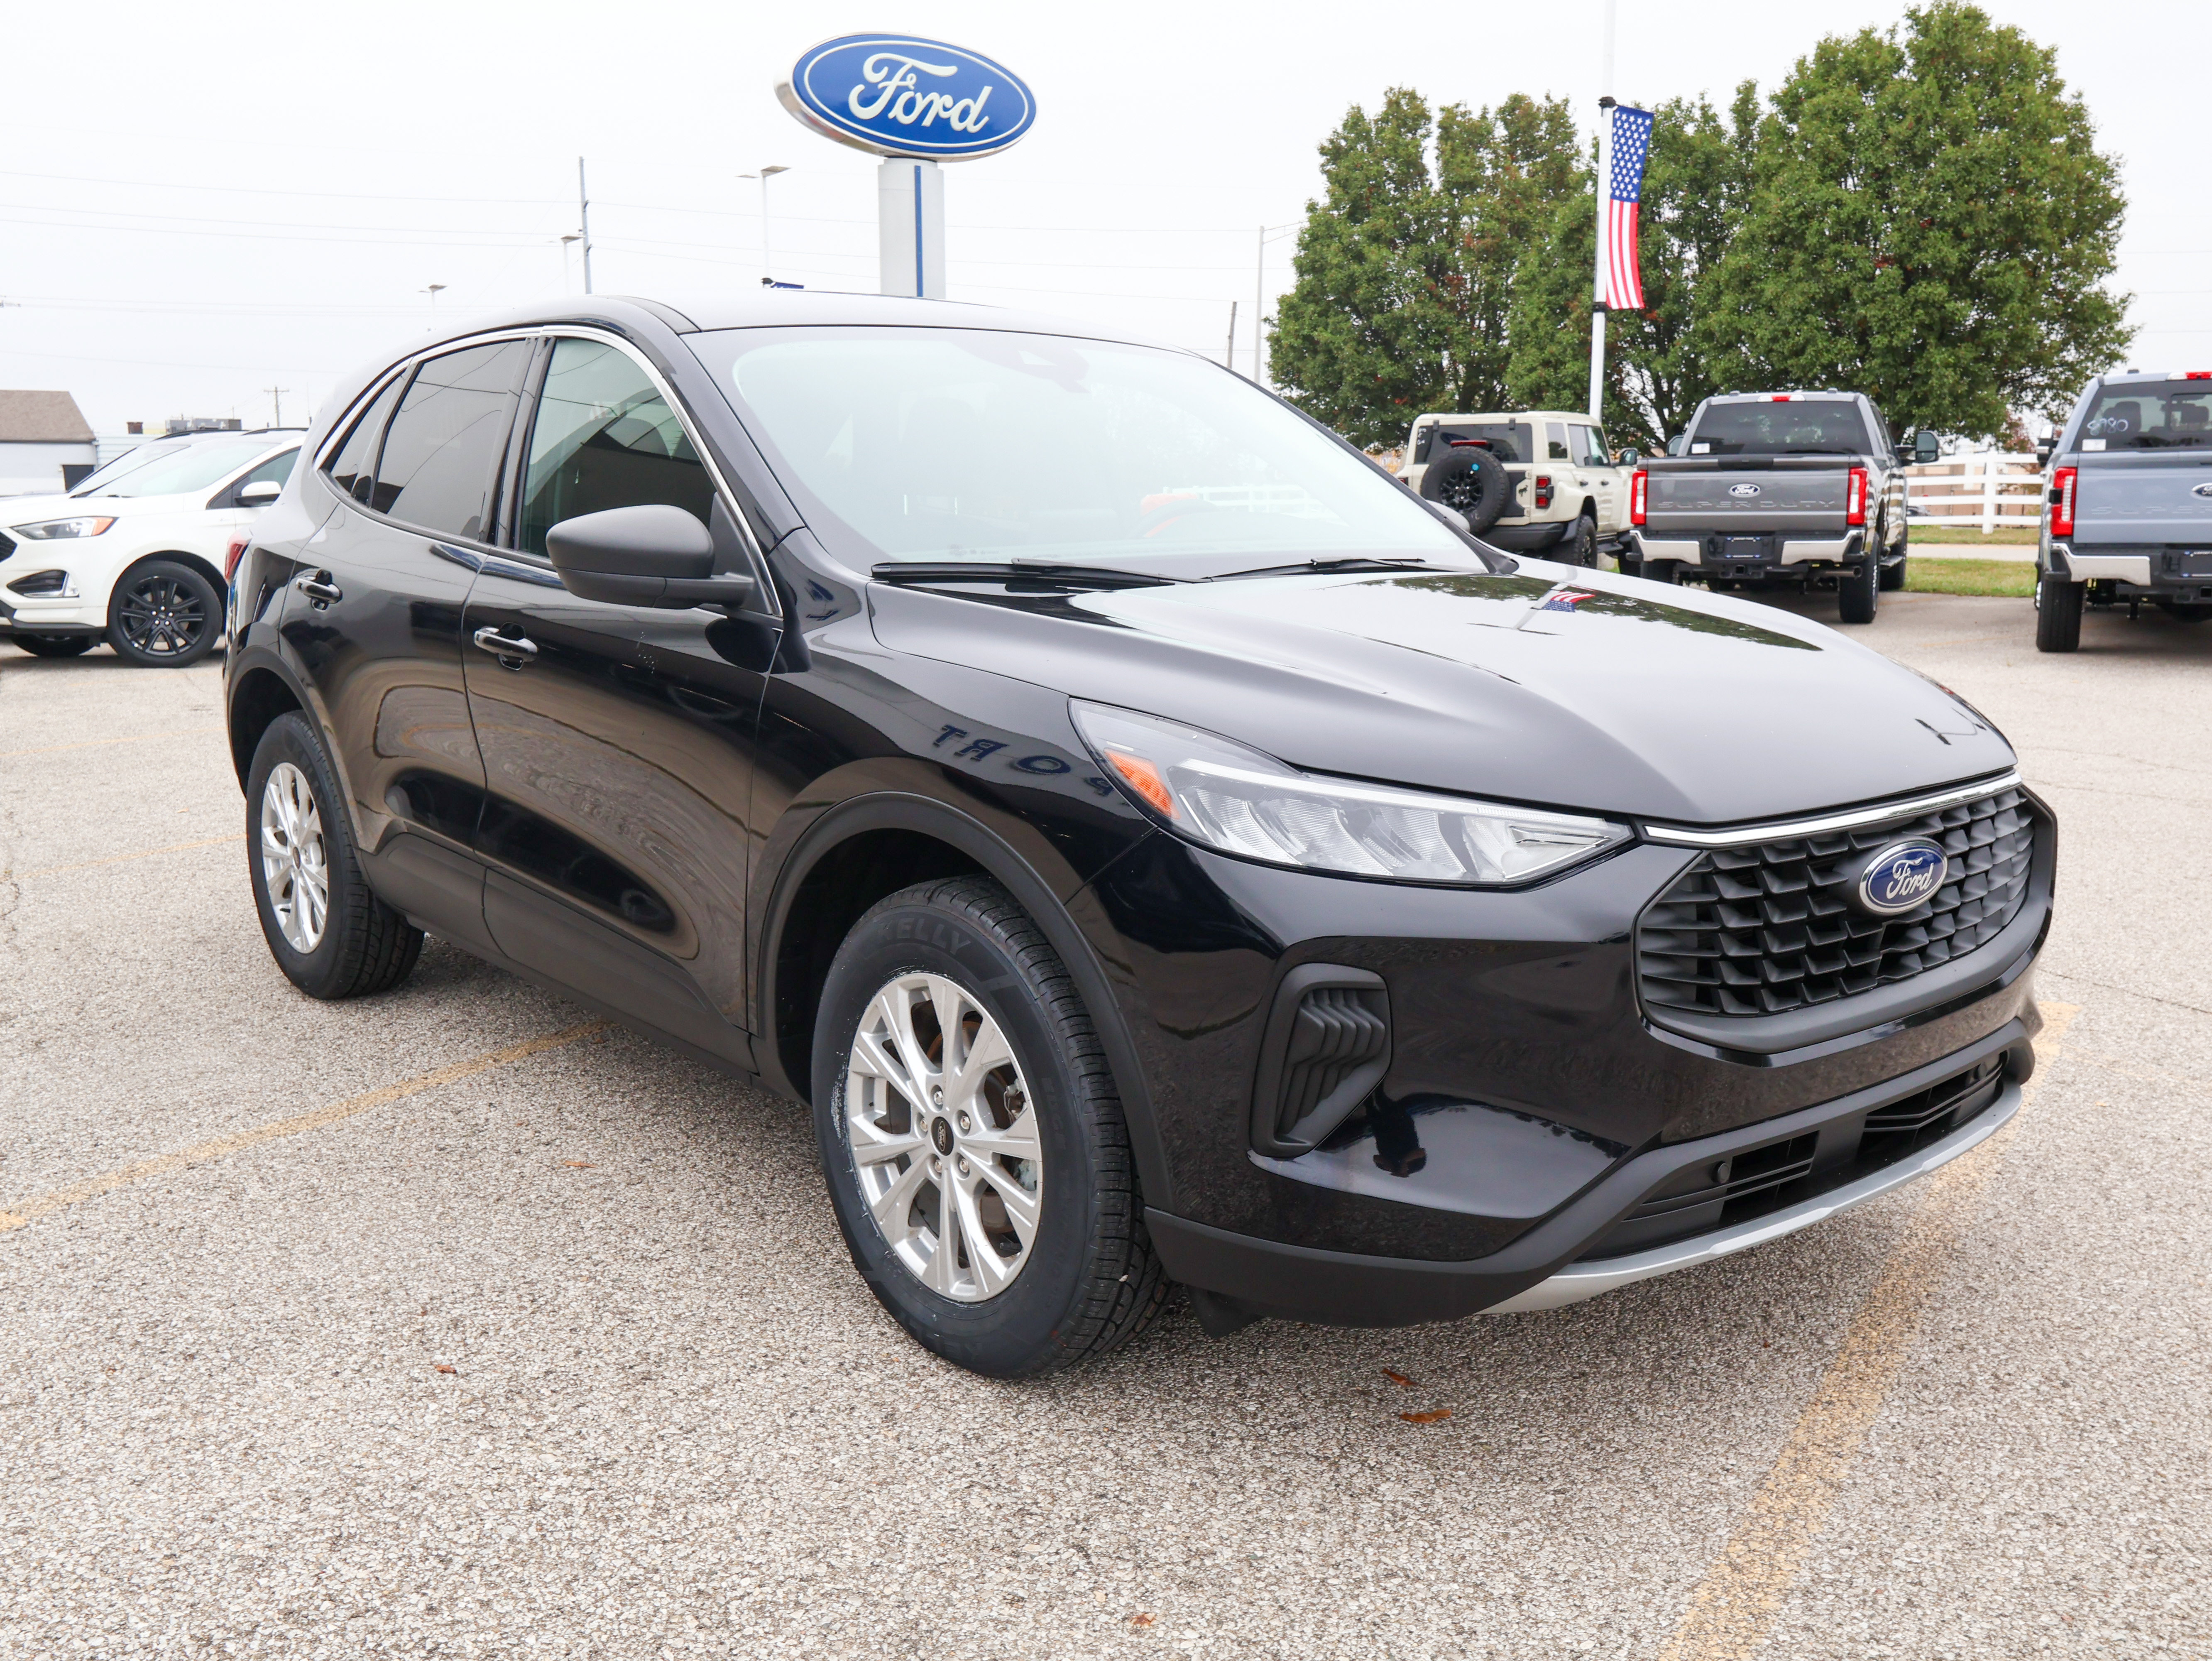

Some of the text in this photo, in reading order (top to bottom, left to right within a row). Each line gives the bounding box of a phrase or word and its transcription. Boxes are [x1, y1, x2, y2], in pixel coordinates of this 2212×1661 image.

[848, 53, 993, 133] Ford
[1735, 485, 1755, 495] Ford
[1886, 857, 1934, 899] Ford
